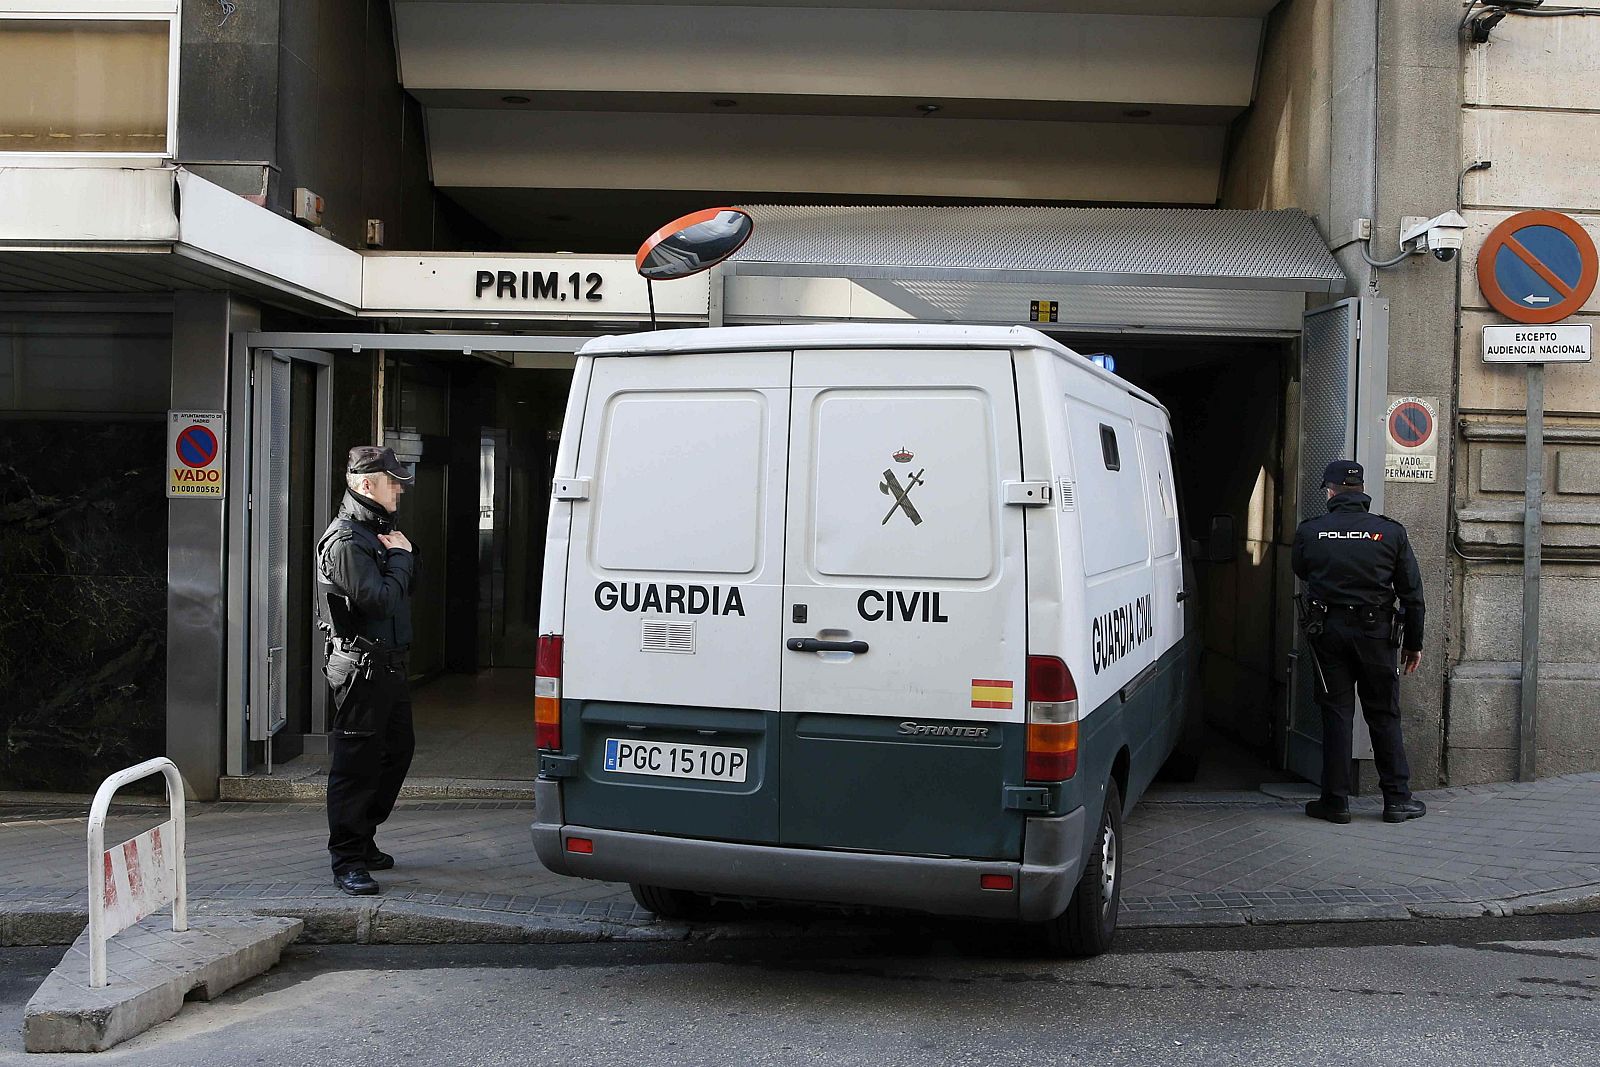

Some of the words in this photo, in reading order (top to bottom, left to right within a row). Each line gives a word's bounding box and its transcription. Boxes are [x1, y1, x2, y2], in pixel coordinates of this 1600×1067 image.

[475, 270, 603, 301] PRIM,12
[1515, 332, 1557, 342] EXCEPTO
[1487, 345, 1536, 355] AUDIENCIA
[1539, 345, 1586, 354] NACIONAL
[1399, 457, 1421, 466] VADO
[174, 469, 219, 482] VADO
[1385, 468, 1434, 479] PERMANENTE
[172, 485, 220, 493] 0100000562
[1318, 531, 1371, 540] POLICIA
[594, 581, 746, 617] GUARDIA
[856, 589, 950, 624] CIVIL
[1092, 602, 1135, 676] GUARDIA
[1136, 593, 1153, 647] CIVIL
[608, 758, 615, 766] E
[618, 743, 662, 771] PGC
[669, 747, 744, 777] 1510P
